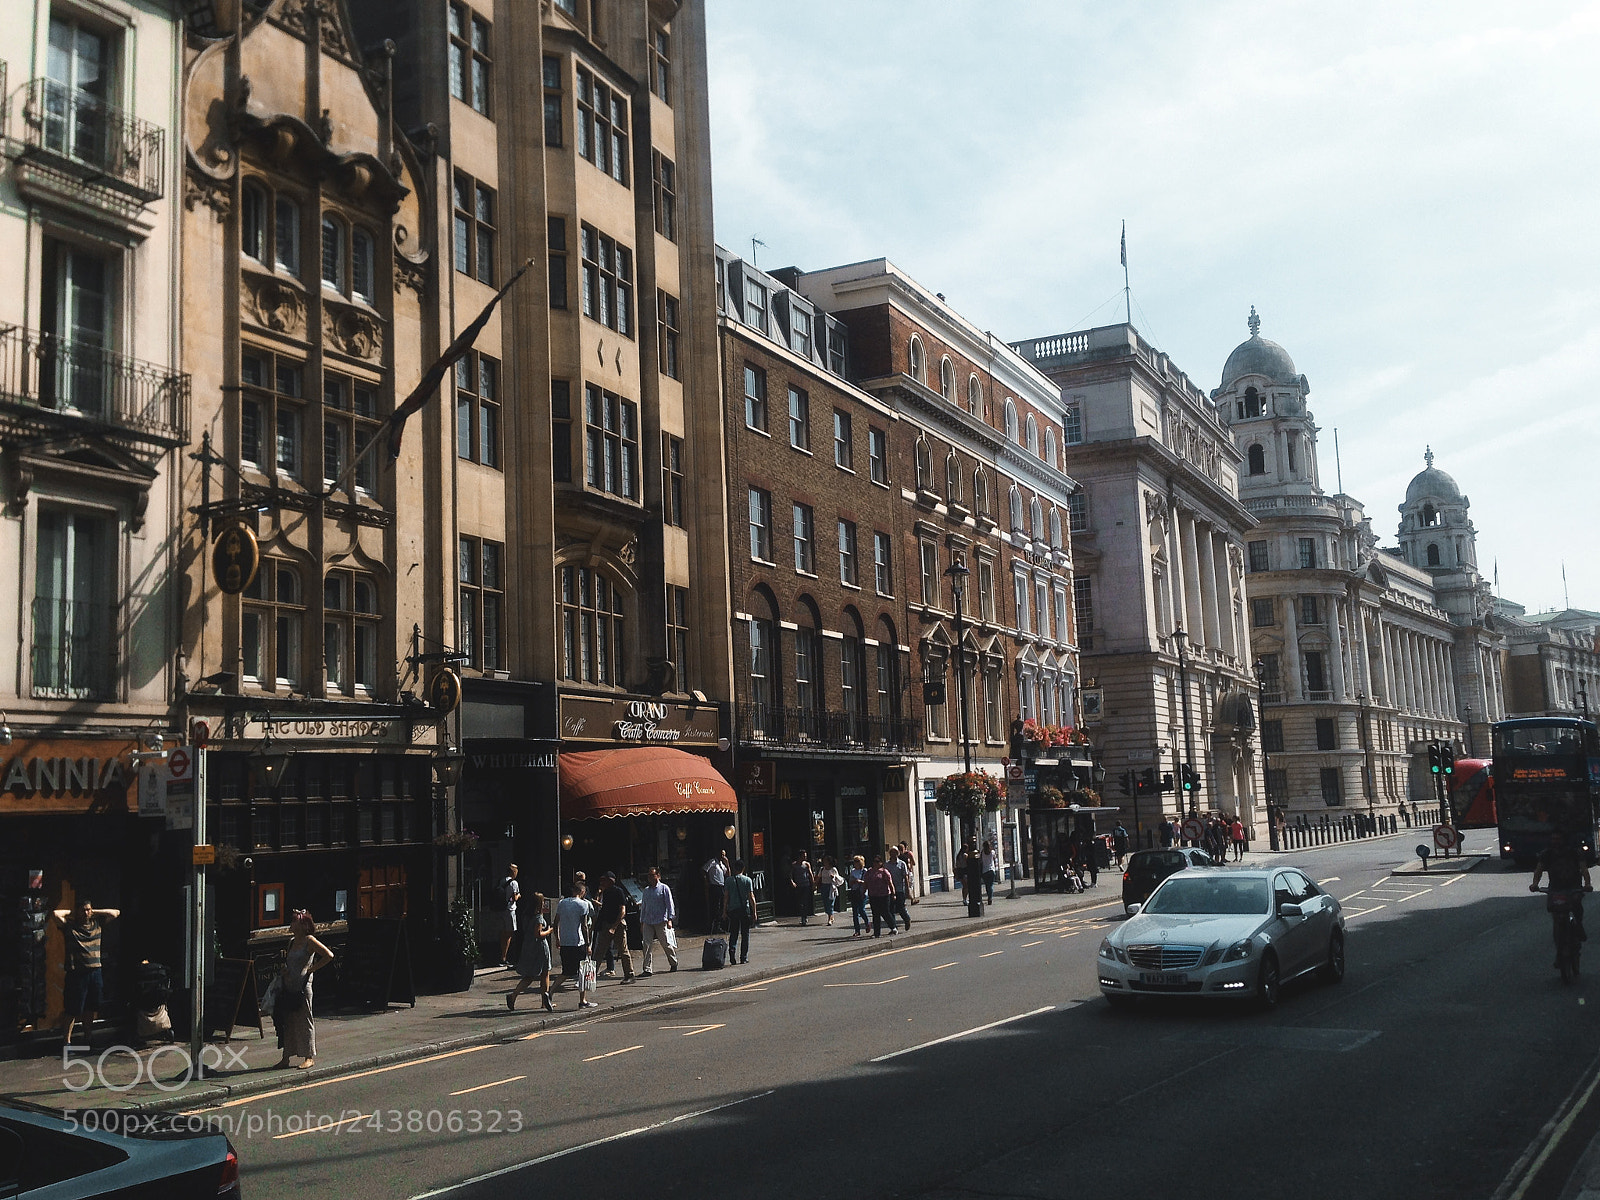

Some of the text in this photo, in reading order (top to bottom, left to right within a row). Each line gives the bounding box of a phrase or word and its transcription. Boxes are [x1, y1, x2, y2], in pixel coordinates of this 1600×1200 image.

[628, 700, 668, 721] GRAND
[295, 720, 326, 735] OLD
[471, 752, 554, 769] WHITEHALL
[0, 757, 126, 791] ANNIA
[504, 824, 514, 838] 41
